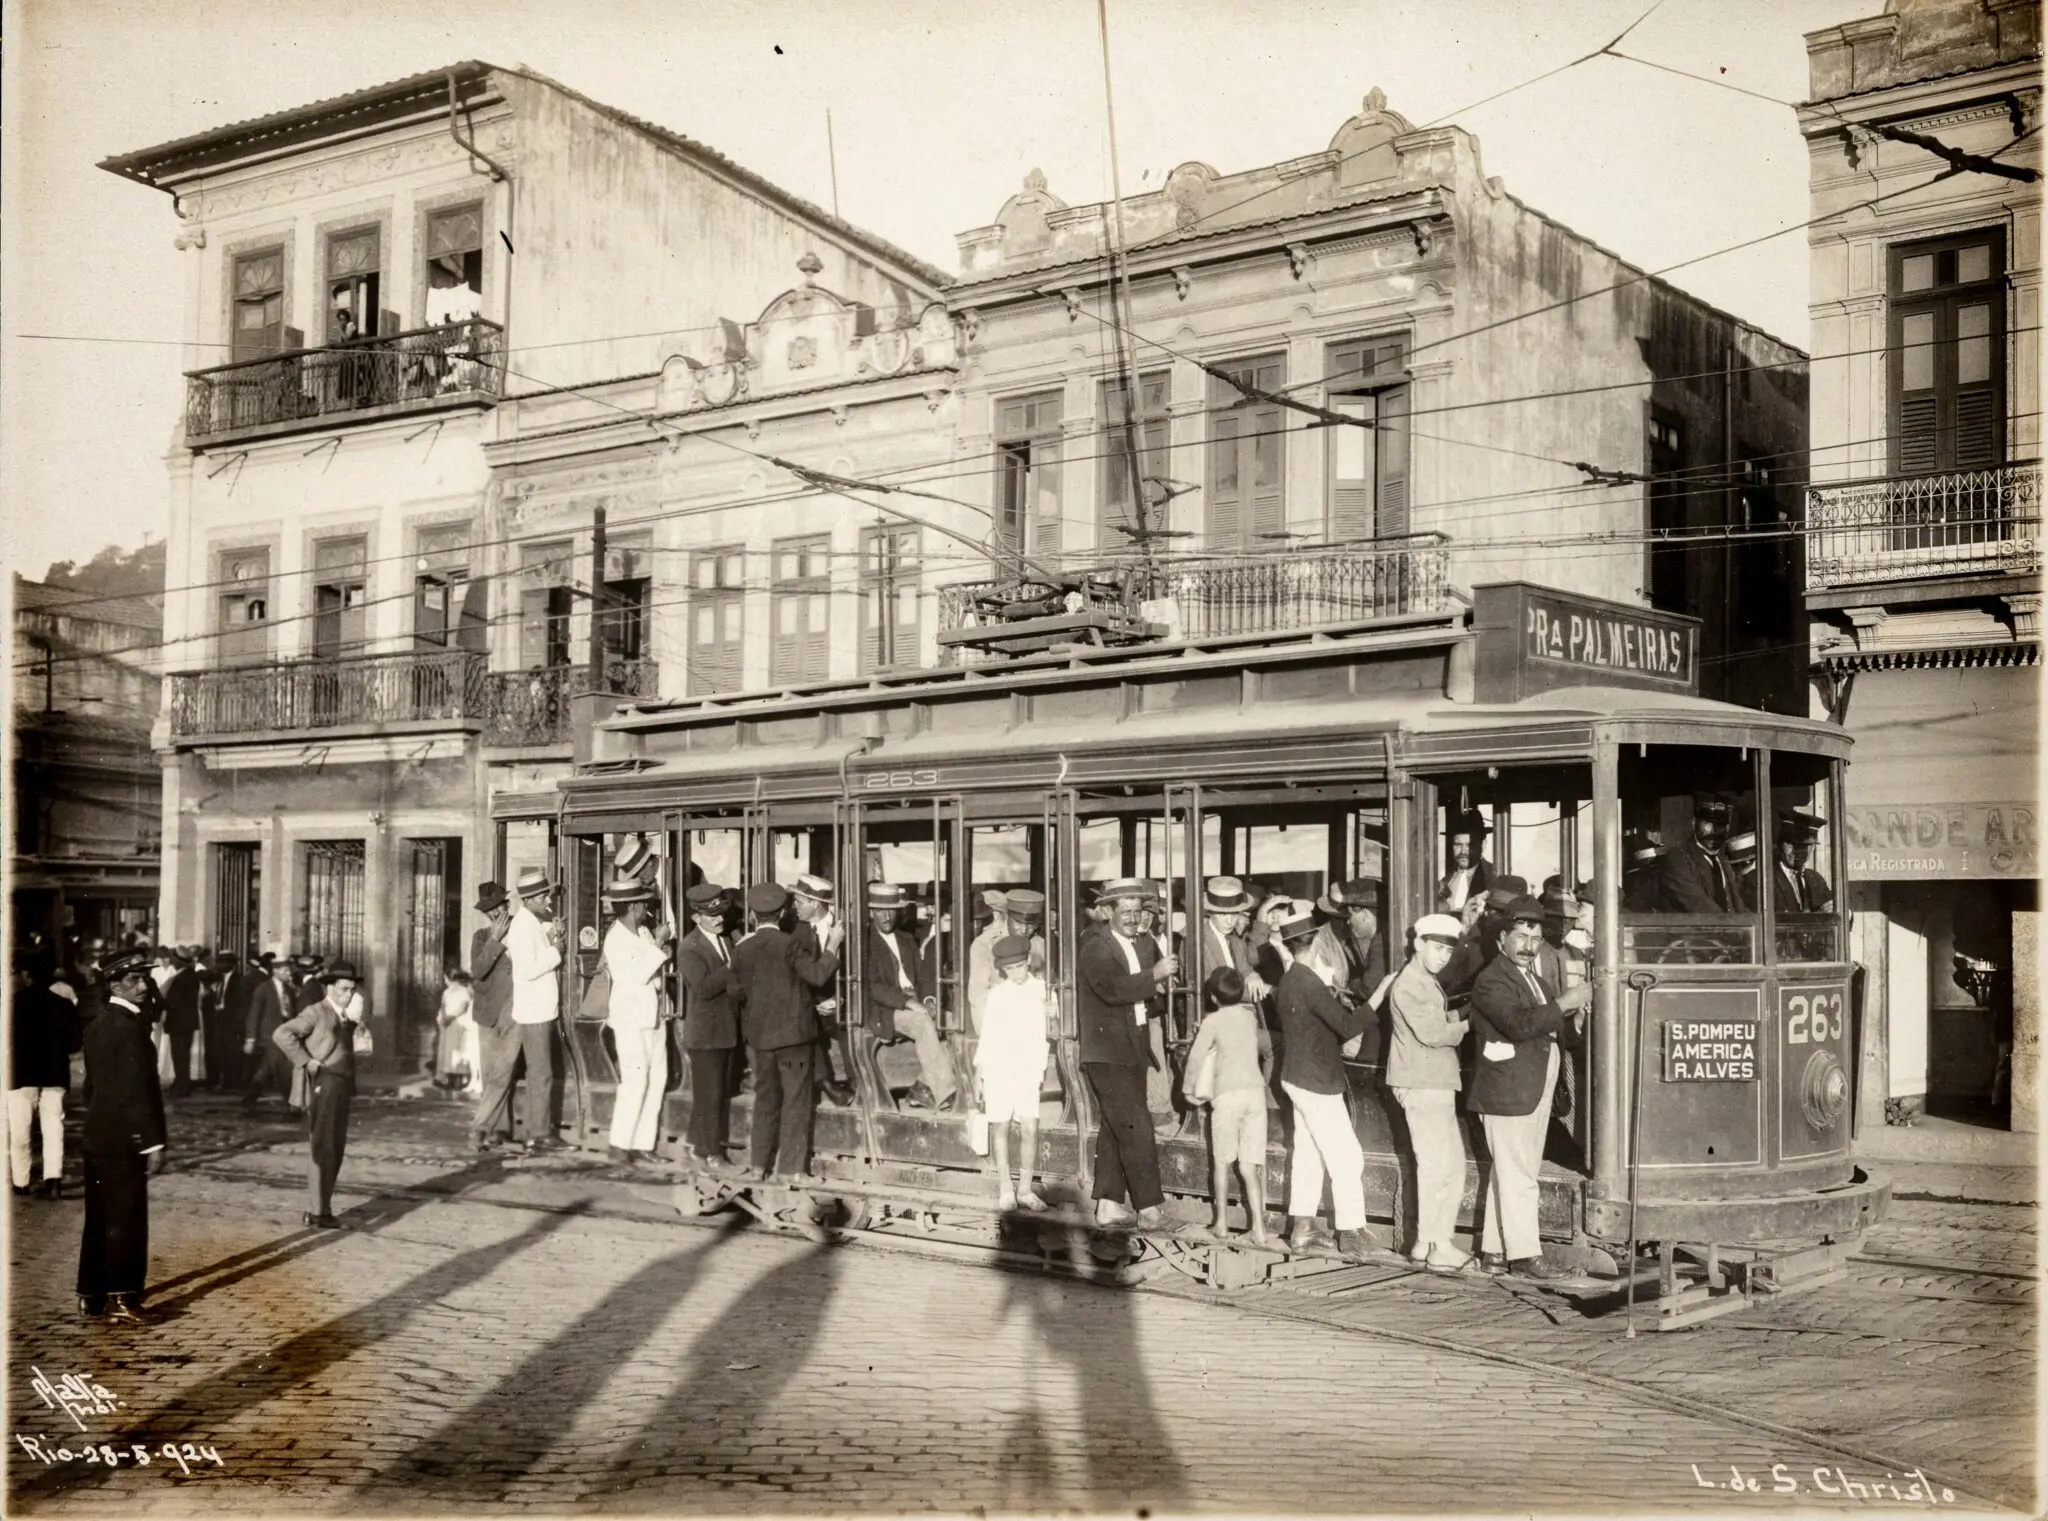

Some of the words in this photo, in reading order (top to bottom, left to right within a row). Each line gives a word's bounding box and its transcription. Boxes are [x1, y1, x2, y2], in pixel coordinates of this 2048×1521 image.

[1570, 615, 1681, 673] PALMEIRAS
[867, 769, 938, 788] 263
[1788, 993, 1842, 1044] 263
[1672, 1044, 1754, 1060] AMERICA
